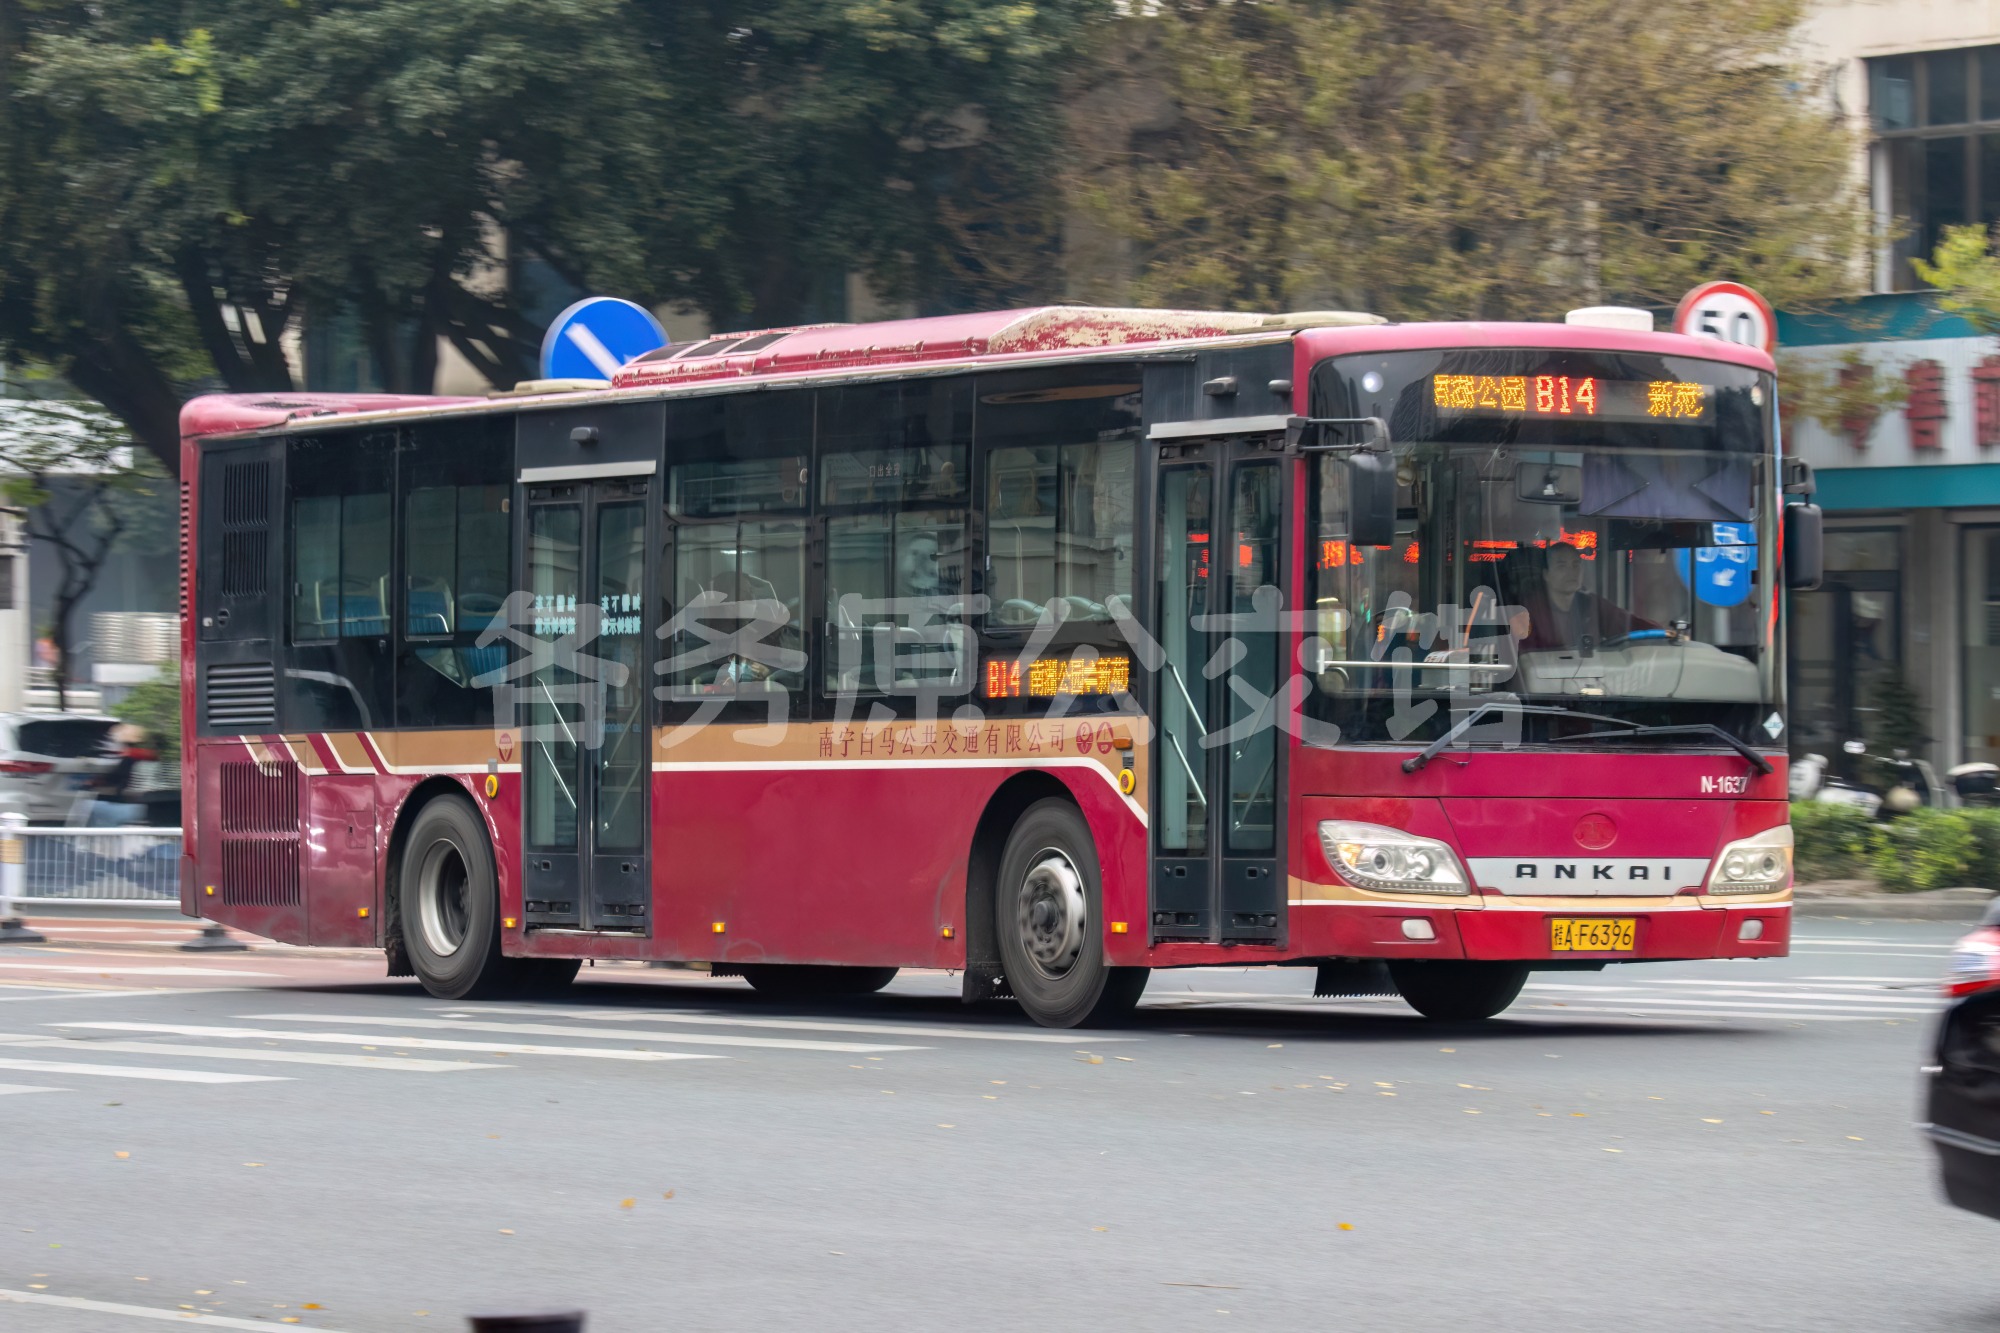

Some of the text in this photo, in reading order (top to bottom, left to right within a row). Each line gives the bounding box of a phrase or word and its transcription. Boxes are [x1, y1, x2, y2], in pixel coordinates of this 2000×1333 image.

[1534, 374, 1596, 415] B14
[987, 660, 1021, 698] B14
[818, 722, 1065, 758] 南宁白马公共交通有限公司
[1700, 775, 1748, 794] N-1637
[1515, 863, 1671, 881] ANKAI
